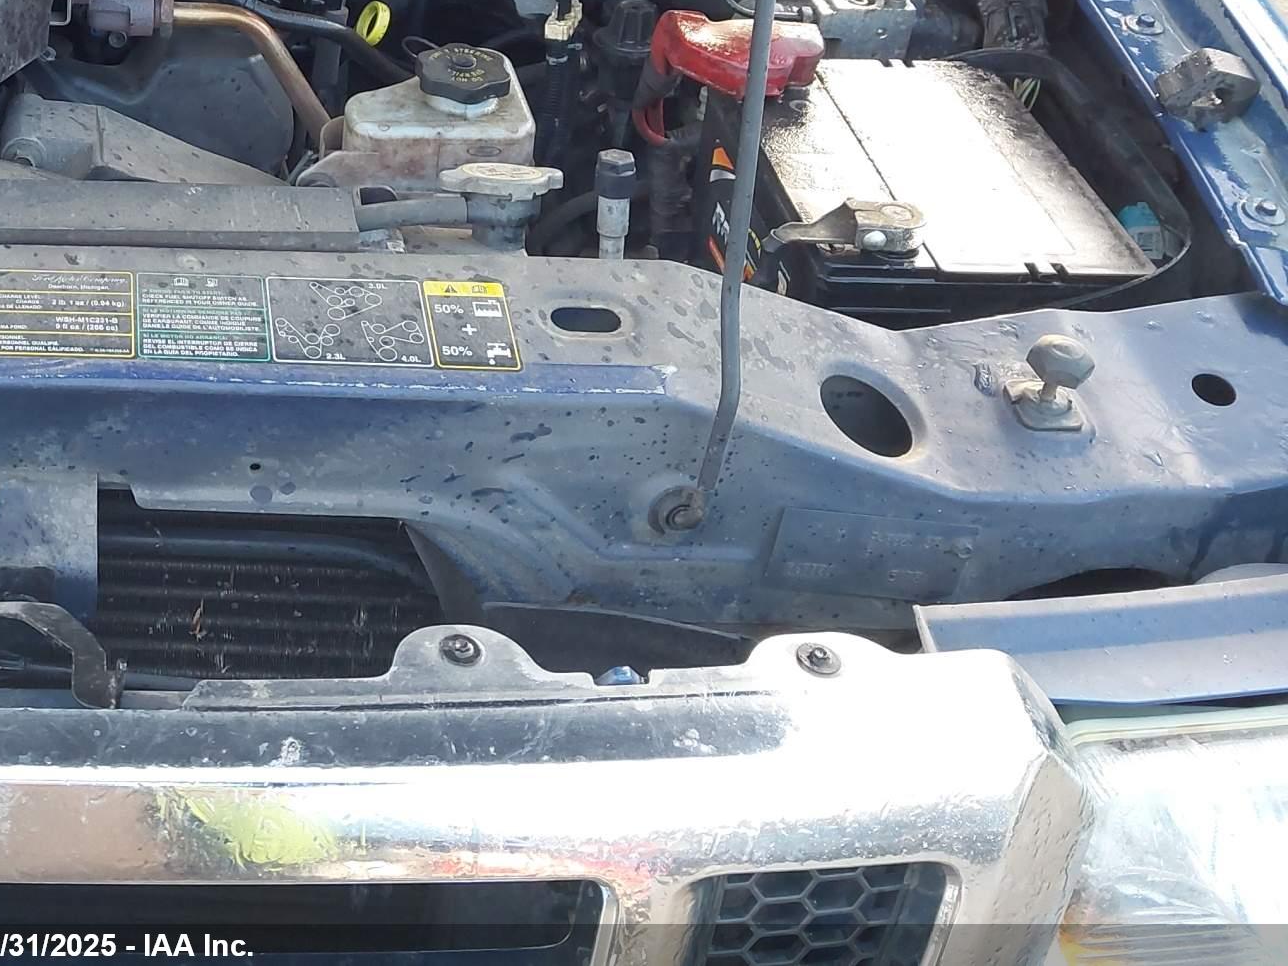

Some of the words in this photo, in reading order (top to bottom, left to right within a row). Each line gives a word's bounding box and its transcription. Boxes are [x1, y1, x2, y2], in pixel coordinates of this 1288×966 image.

[434, 304, 464, 315] 50%
[442, 345, 473, 357] 50%
[326, 353, 346, 361] 2.3L
[401, 355, 422, 363] 4.0L
